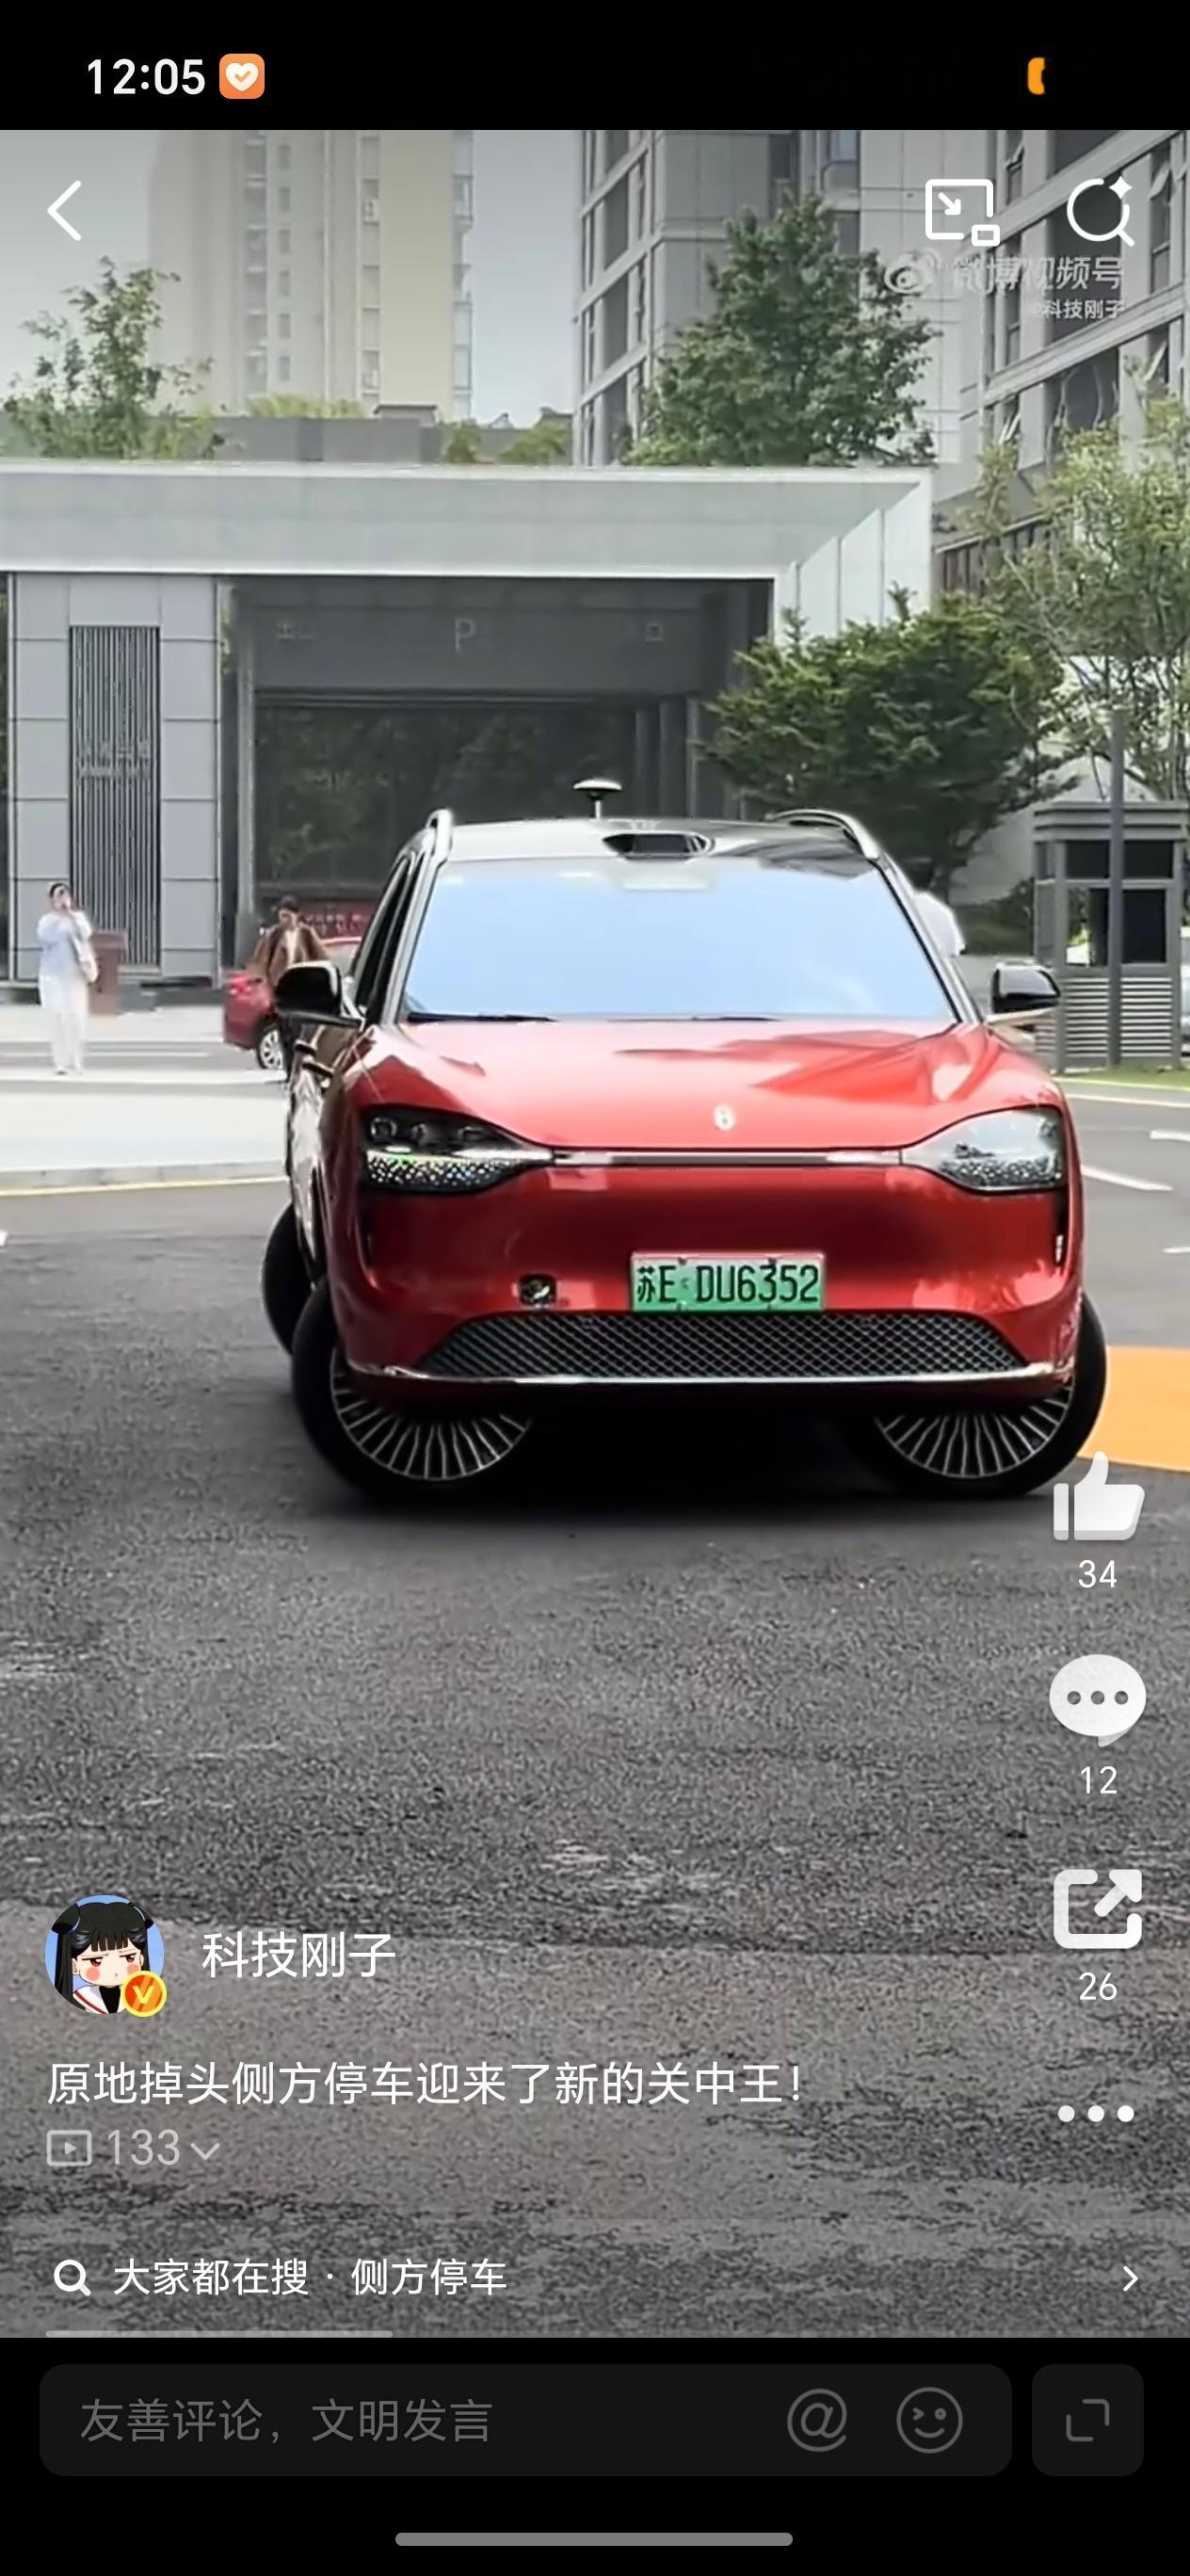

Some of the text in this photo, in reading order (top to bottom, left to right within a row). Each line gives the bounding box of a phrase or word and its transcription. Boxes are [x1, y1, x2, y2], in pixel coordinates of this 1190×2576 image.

[454, 618, 475, 652] P
[636, 1264, 819, 1303] 苏E DU6352
